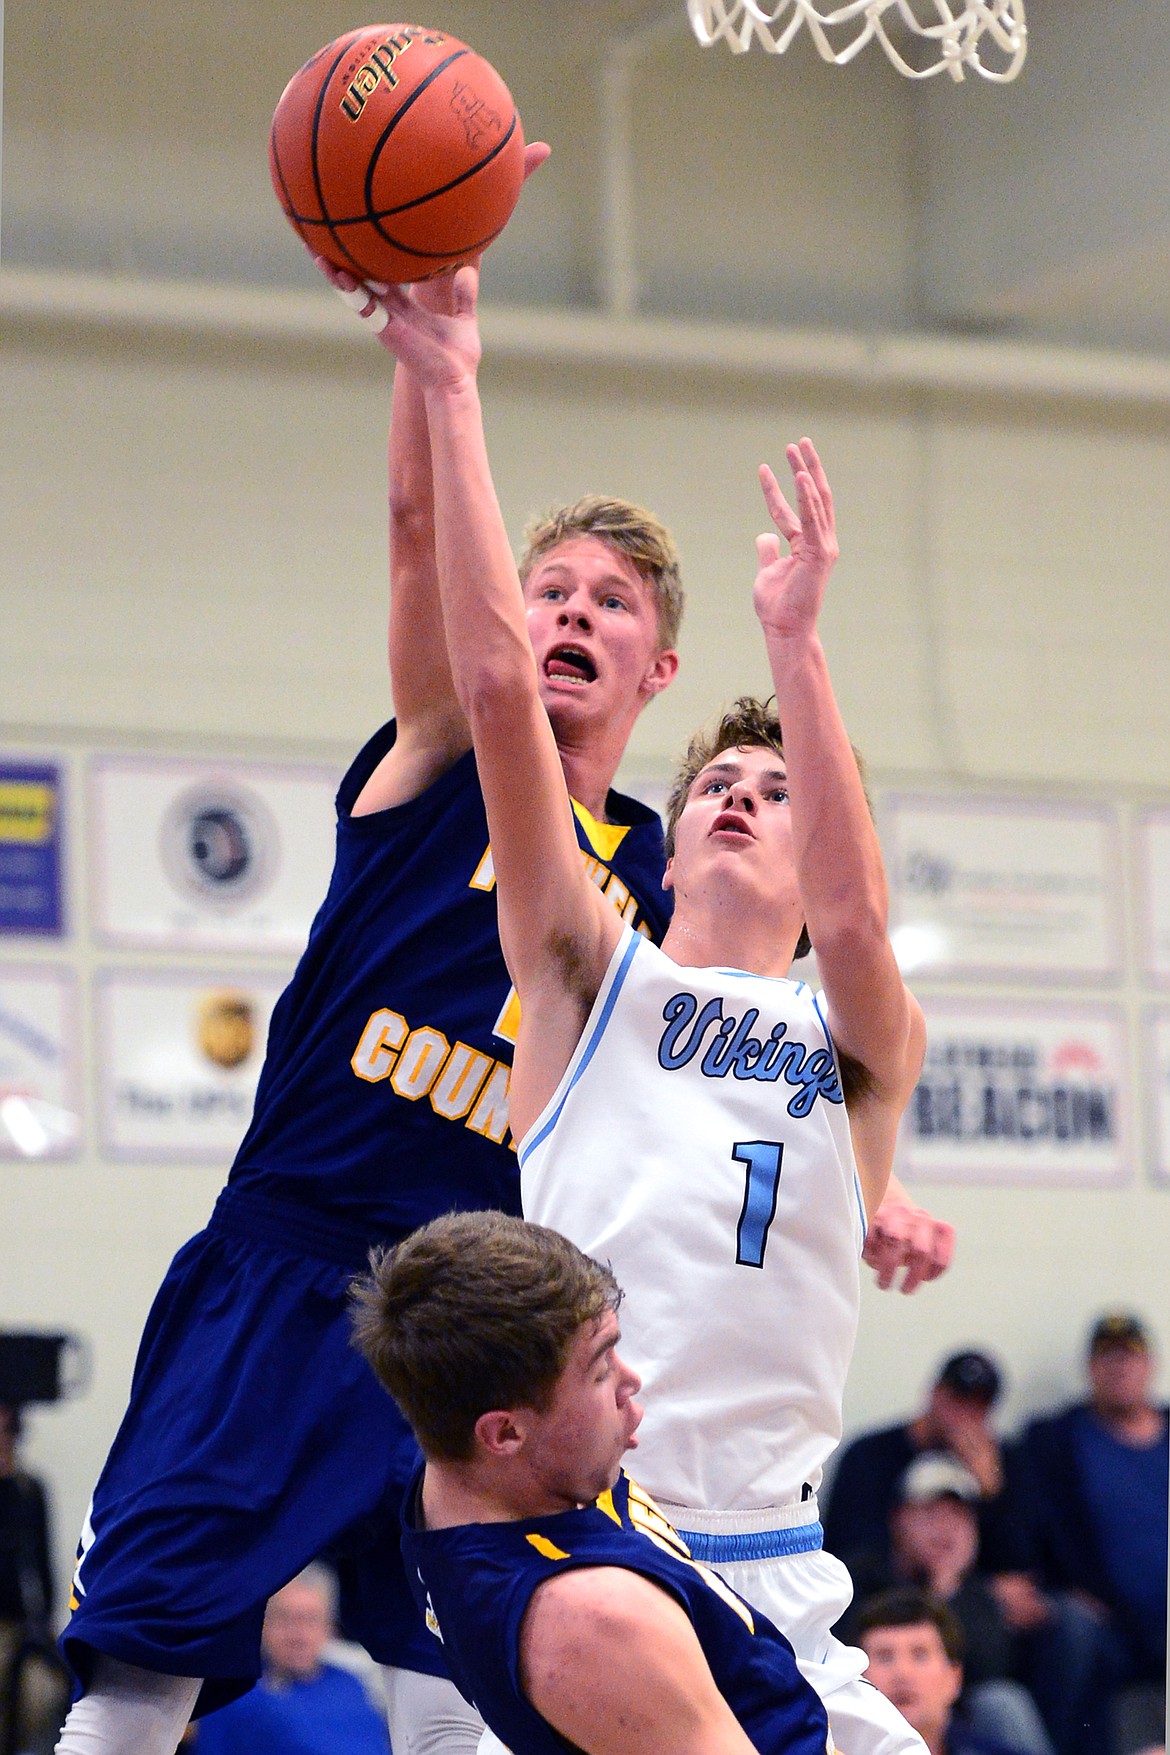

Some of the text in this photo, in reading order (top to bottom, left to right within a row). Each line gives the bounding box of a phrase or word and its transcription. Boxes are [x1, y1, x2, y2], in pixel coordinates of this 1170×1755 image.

[350, 1007, 519, 1153] COUN
[657, 991, 844, 1118] Vikings
[731, 1140, 785, 1270] 1
